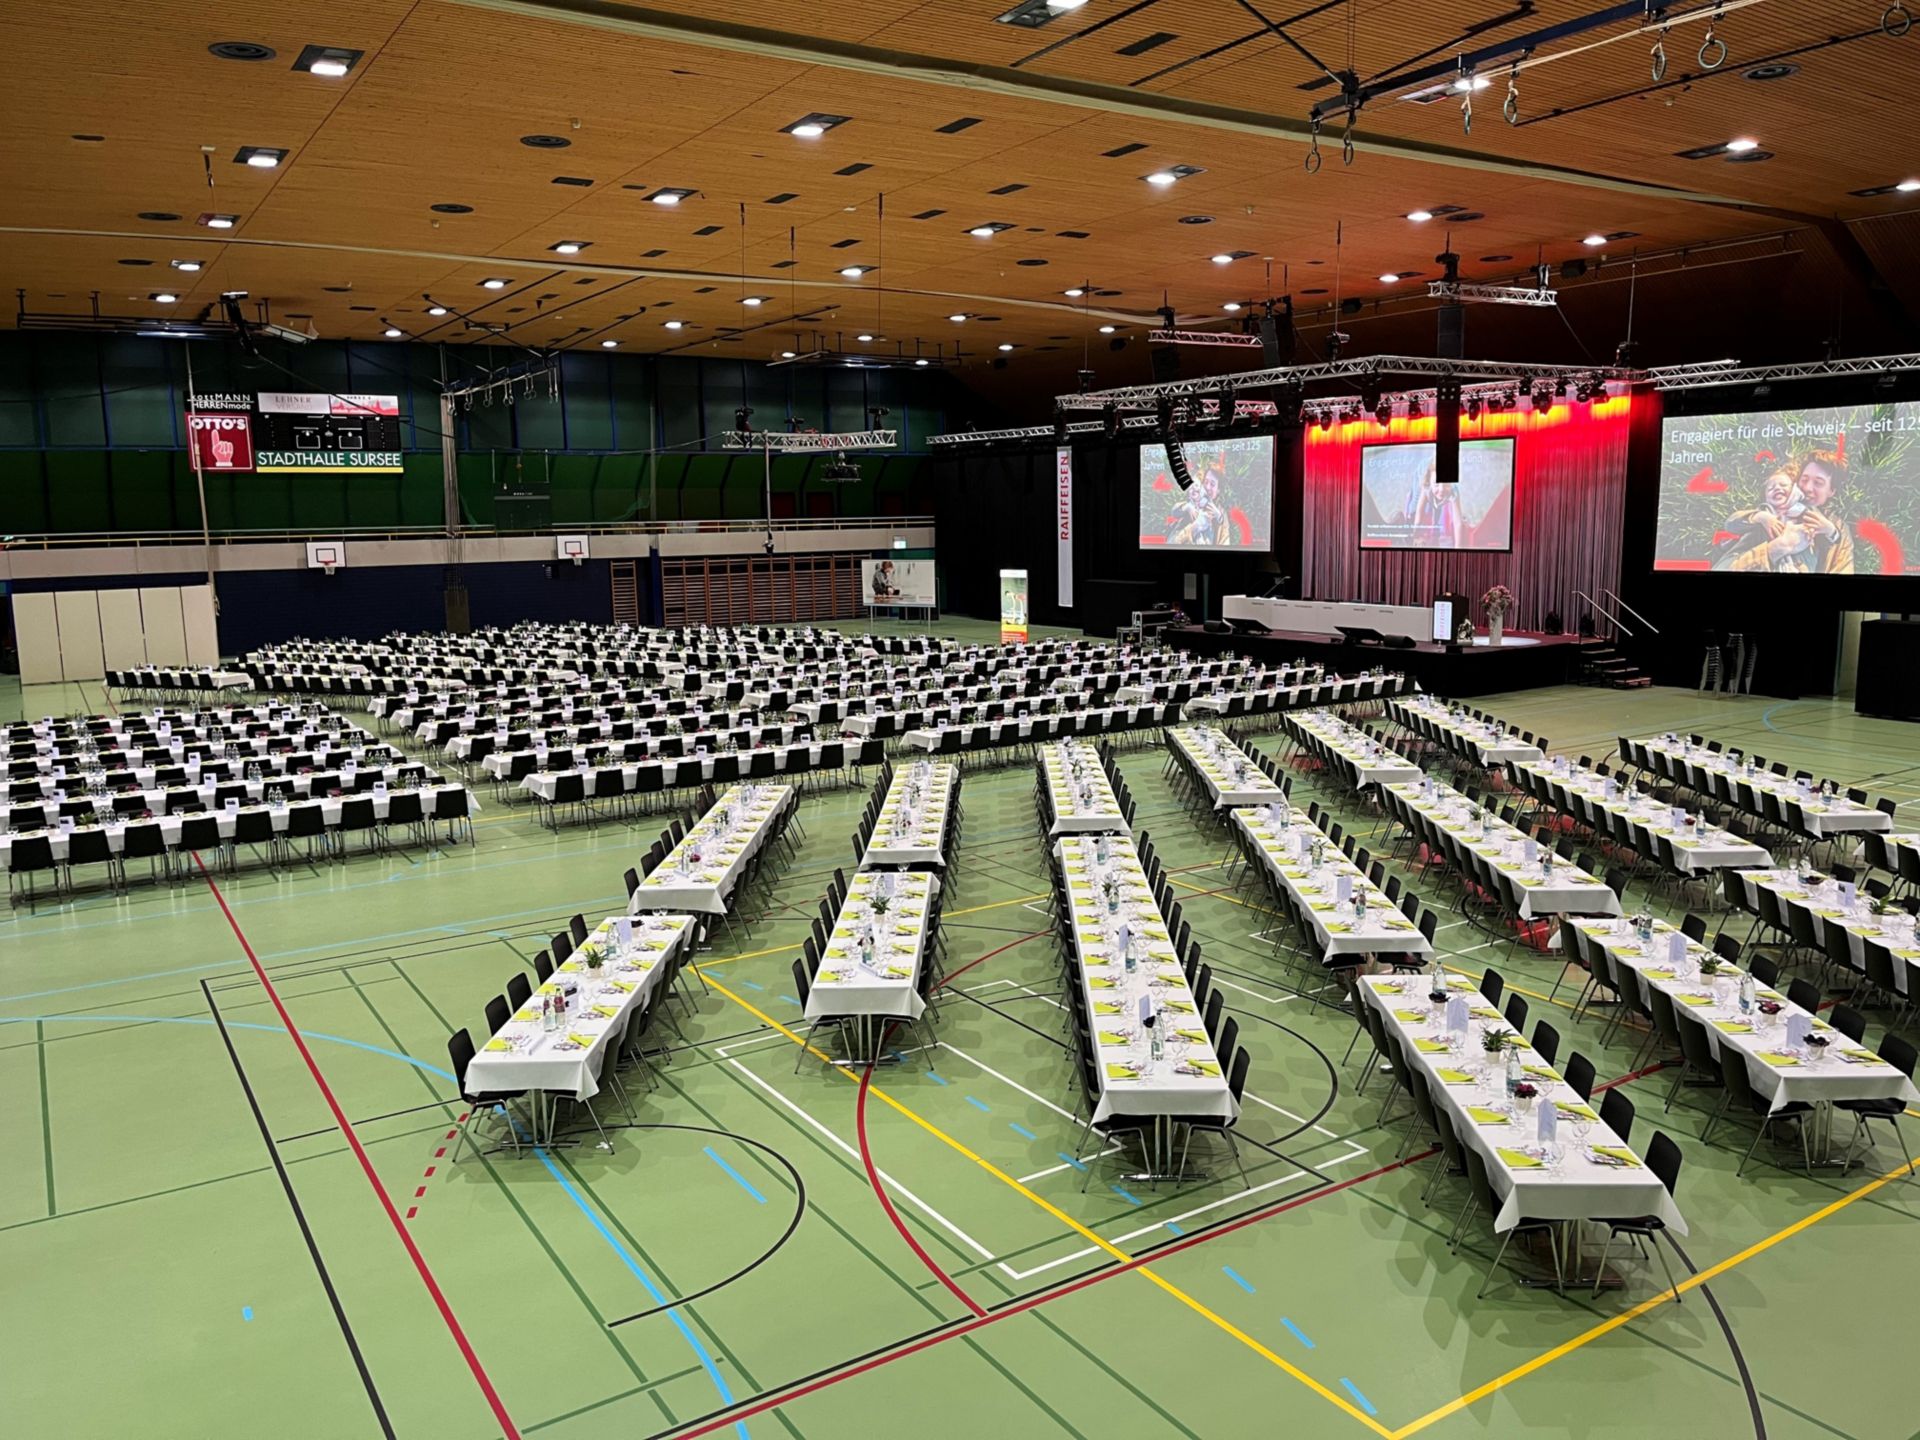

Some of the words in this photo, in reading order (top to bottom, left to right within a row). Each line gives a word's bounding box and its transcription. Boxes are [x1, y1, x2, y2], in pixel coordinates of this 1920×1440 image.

[191, 418, 246, 430] OTTO'S
[1671, 428, 1734, 444] Engagiert
[1737, 425, 1758, 439] für
[1761, 424, 1783, 438] die
[1787, 420, 1847, 436] Schweiz
[1864, 418, 1893, 433] seit
[258, 452, 345, 466] STADTHALLE
[350, 453, 400, 466] SURSEE
[1669, 450, 1713, 464] Jahren
[1060, 456, 1069, 540] RAIFFEISEN
